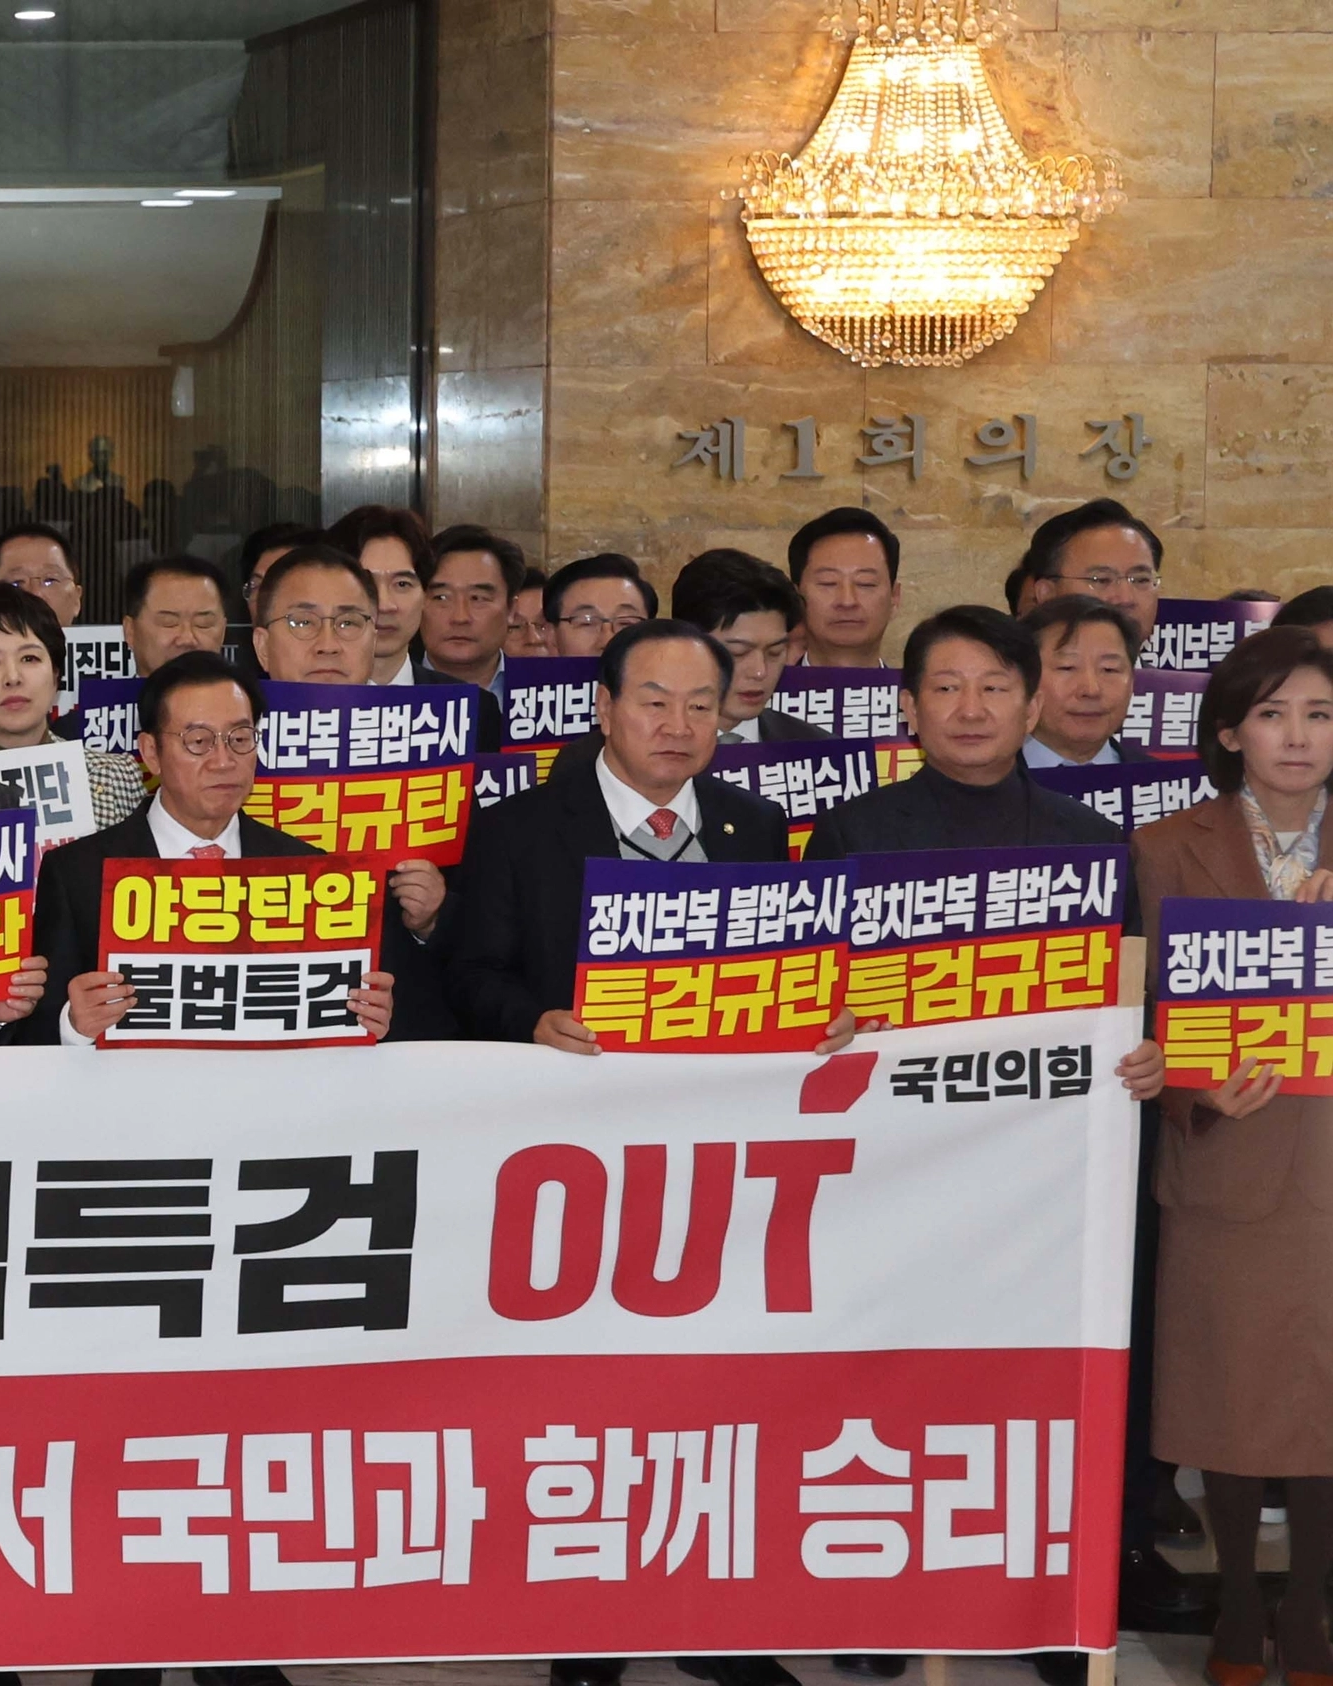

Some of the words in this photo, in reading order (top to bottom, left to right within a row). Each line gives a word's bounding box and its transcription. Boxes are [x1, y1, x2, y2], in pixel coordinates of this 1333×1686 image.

[349, 697, 471, 768] 불법수사
[509, 681, 601, 740] 정치보
[112, 870, 377, 946] 야당탄압
[587, 889, 720, 957] 정치보복
[726, 875, 847, 948] 불법수사
[850, 872, 978, 946] 정치보복
[985, 858, 1118, 932] 불법수사
[117, 959, 365, 1034] 불법특검
[579, 951, 840, 1044] 특검규탄
[845, 931, 1114, 1031] 특검규탄
[1167, 926, 1305, 994] 정치보복
[889, 1044, 1094, 1104] 국민의힘
[487, 1137, 857, 1322] OUT
[117, 1427, 487, 1596] 국민과
[523, 1421, 759, 1584] 함께
[798, 1417, 1076, 1581] 승리!
